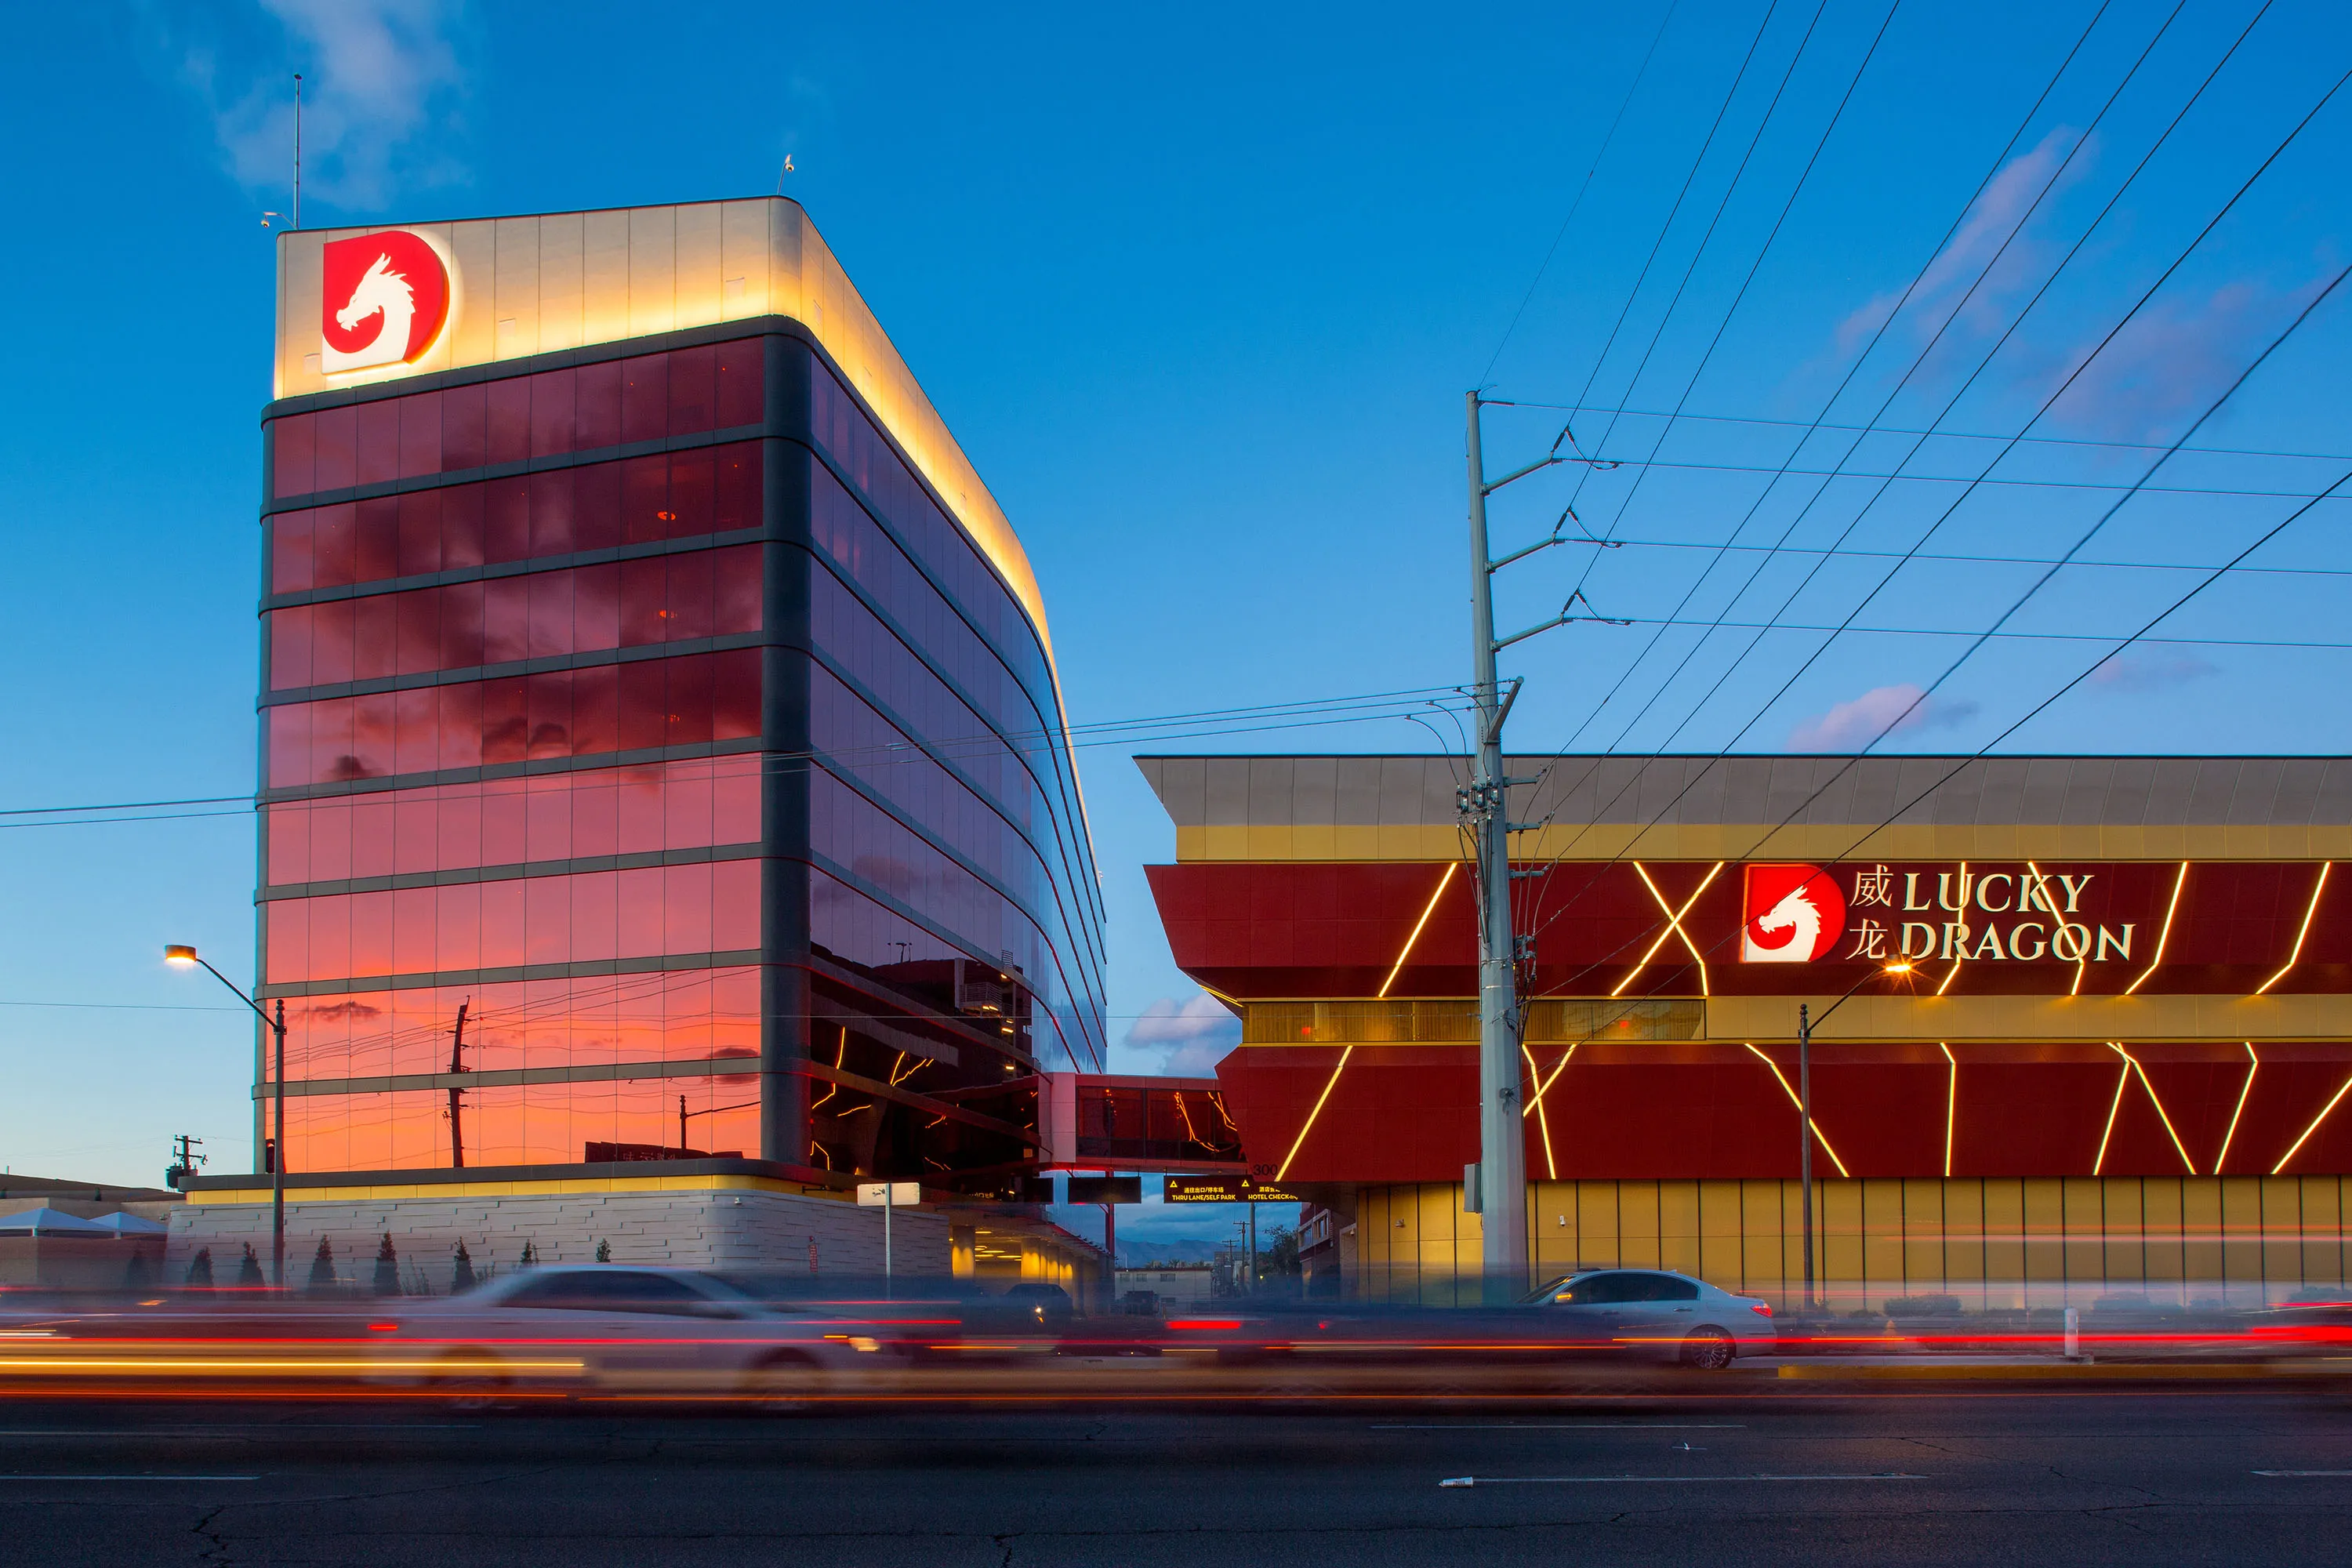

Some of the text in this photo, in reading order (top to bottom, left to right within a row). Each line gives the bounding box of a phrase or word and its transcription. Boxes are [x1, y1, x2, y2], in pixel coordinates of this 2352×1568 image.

[1901, 873, 2096, 913] LUCKY
[1900, 922, 2137, 961] DRAGON
[1254, 1163, 1278, 1175] 300
